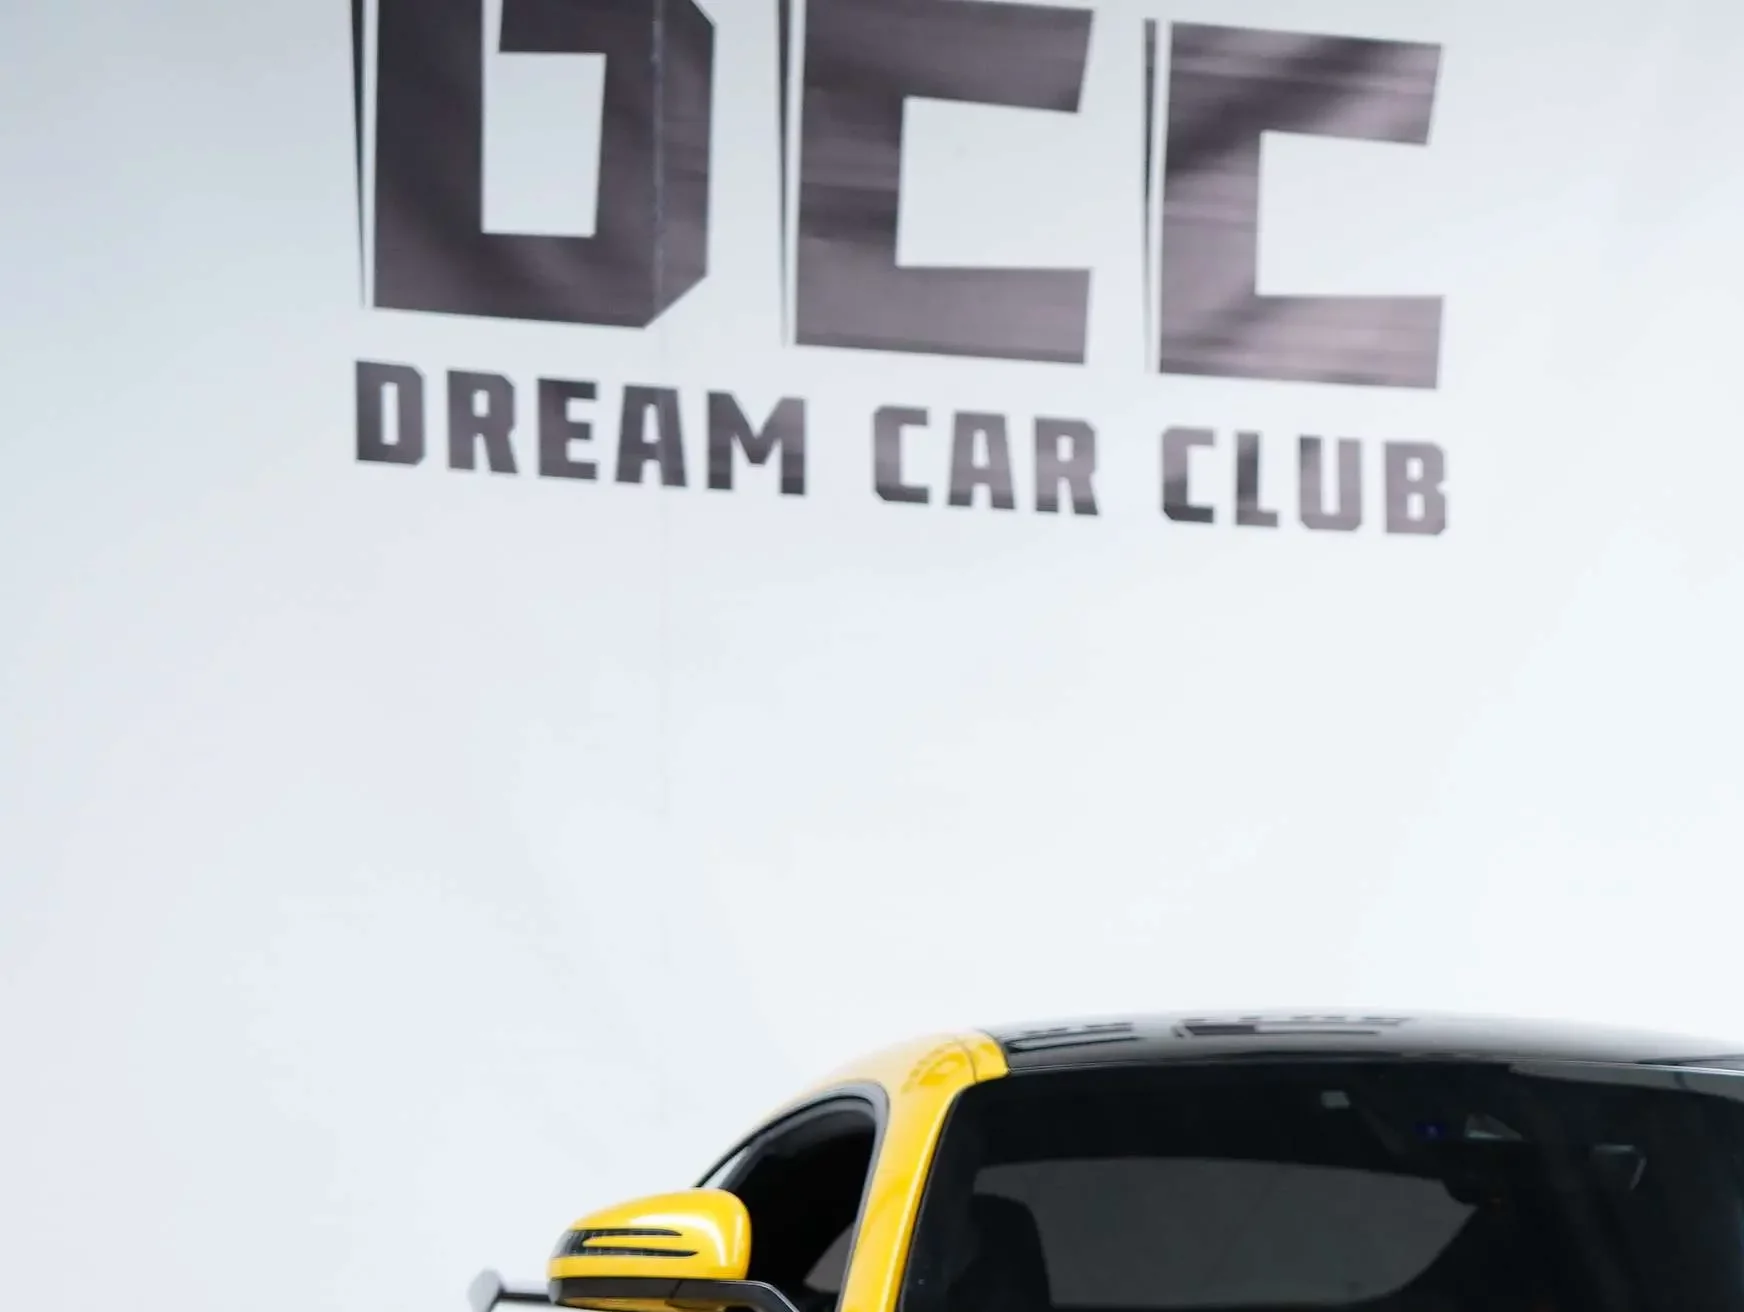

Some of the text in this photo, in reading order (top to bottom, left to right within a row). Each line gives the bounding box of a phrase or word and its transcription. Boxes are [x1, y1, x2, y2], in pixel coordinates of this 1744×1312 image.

[350, 0, 1446, 391] DCC
[355, 359, 1448, 537] DREAM CAR CLUB
